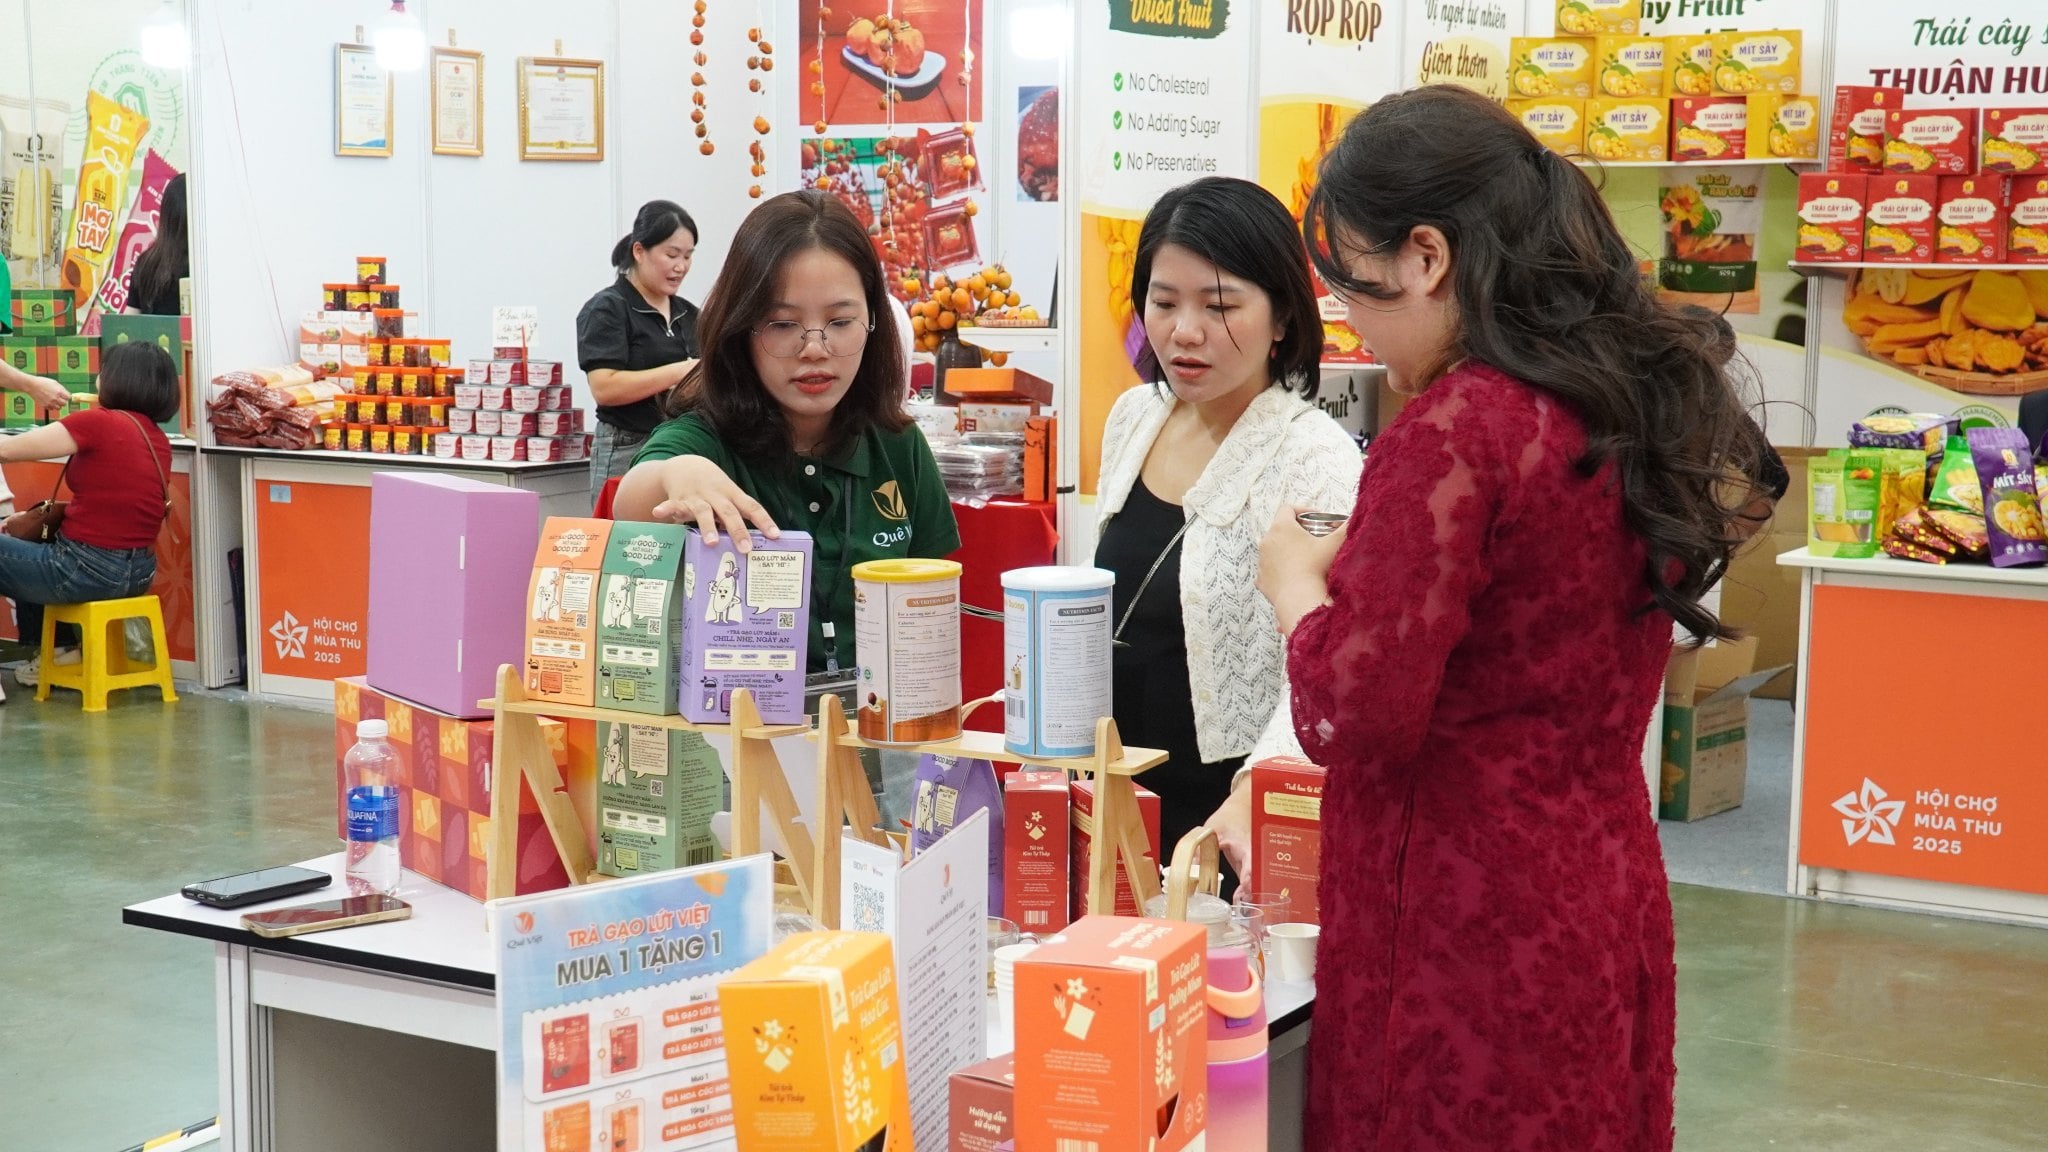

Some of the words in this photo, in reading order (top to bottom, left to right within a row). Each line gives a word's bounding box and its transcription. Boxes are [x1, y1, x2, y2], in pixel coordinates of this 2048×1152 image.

[1178, 0, 1213, 29] Fruit
[1481, 3, 1506, 29] nhiên
[1914, 17, 1971, 46] Trái
[1978, 18, 2032, 56] cây
[1421, 41, 1452, 83] Giòn
[1456, 44, 1488, 80] thơm
[1129, 73, 1145, 91] No
[1148, 74, 1210, 95] Cholesterol
[1869, 58, 1994, 101] THUẬN
[1128, 113, 1144, 130] No
[1147, 114, 1187, 138] Adding
[1190, 116, 1221, 138] Sugar
[1127, 152, 1142, 170] No
[1146, 153, 1217, 172] Preservatives
[84, 203, 112, 225] MƠ
[79, 224, 109, 251] TÂY
[1994, 473, 2015, 488] MÍT
[873, 526, 905, 547] Quê
[314, 616, 332, 633] HỘI
[334, 620, 358, 635] CHỢ
[314, 633, 337, 647] MÙA
[340, 638, 361, 650] THU
[314, 652, 341, 664] 2025
[1916, 788, 1949, 810] HỘI
[1954, 794, 1997, 816] CHỢ
[1914, 811, 1956, 832] MÙA
[1963, 819, 2002, 836] THU
[1913, 836, 1962, 855] 2025
[568, 925, 600, 948] TRÀ
[604, 920, 644, 944] GẠO
[649, 908, 673, 934] LỨT
[678, 902, 711, 928] VIỆT
[557, 955, 612, 986] MUA
[620, 950, 630, 972] 1
[638, 937, 704, 974] TẶNG
[711, 932, 721, 954] 1
